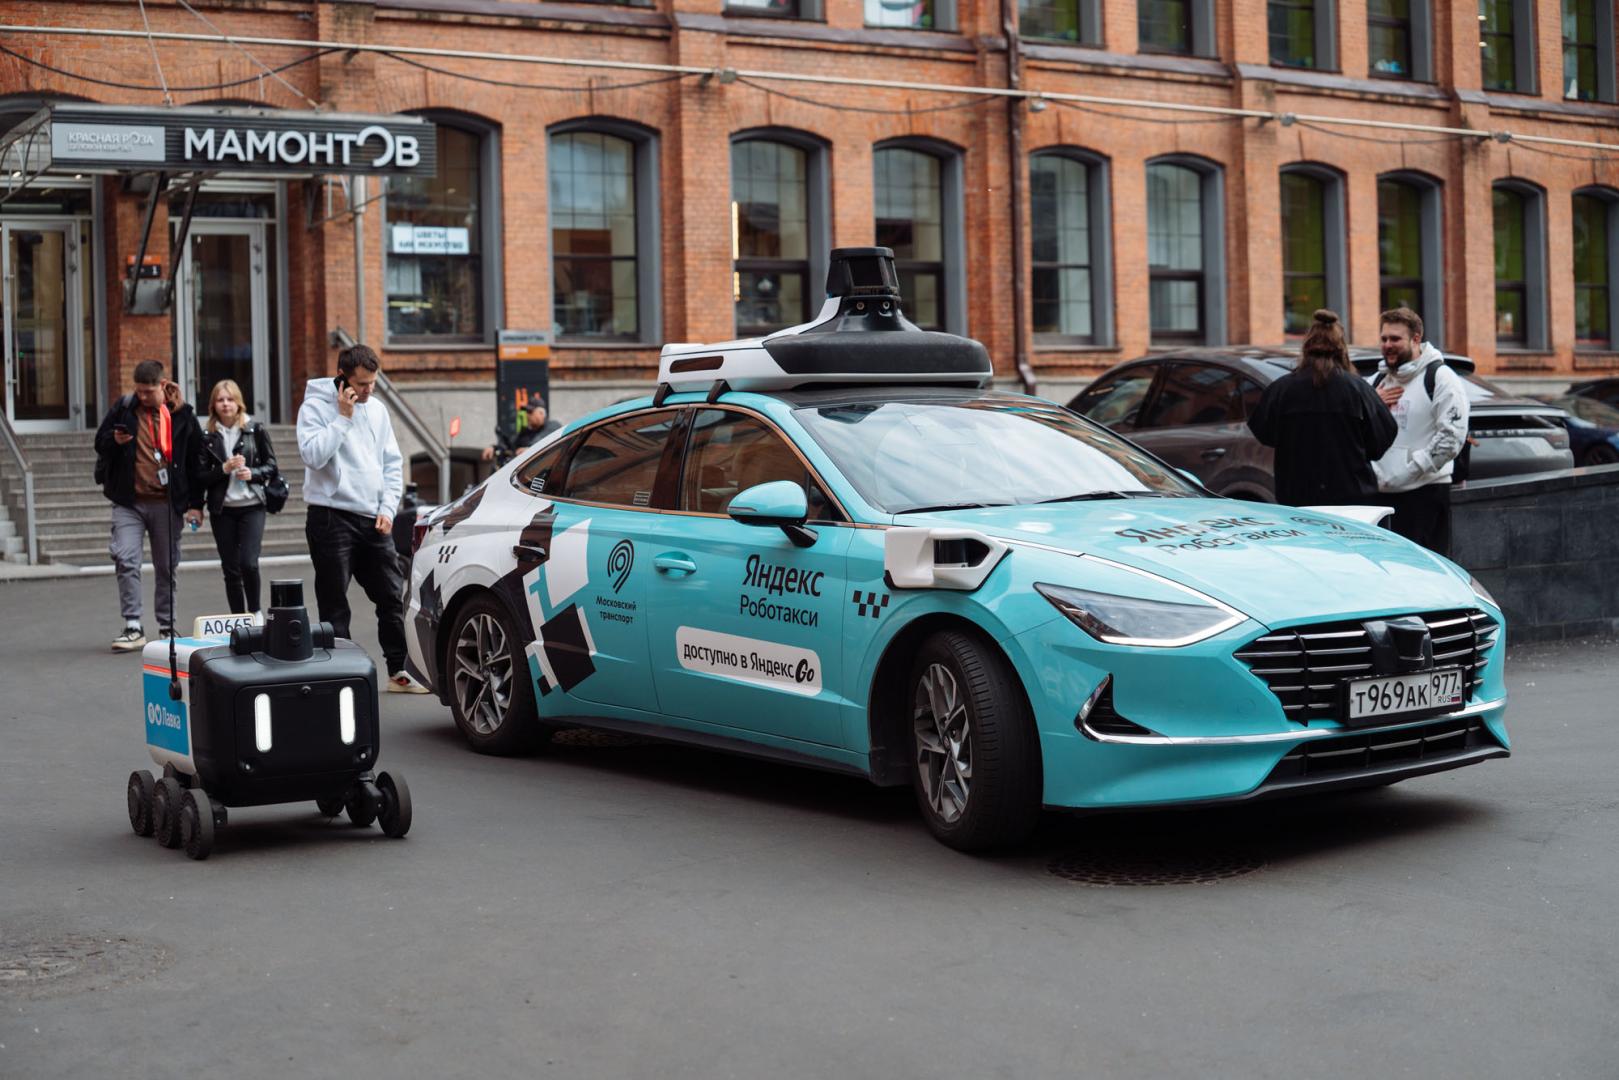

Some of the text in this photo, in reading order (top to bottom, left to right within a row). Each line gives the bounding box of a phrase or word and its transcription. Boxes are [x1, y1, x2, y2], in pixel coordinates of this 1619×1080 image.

[67, 130, 155, 146] КРАСНАЯ РОЗА
[184, 125, 421, 168] МАМОНТОВ
[742, 554, 824, 597] Яндекс
[596, 595, 637, 611] Московский
[740, 594, 818, 627] Роботакси
[600, 611, 633, 624] транспорт
[683, 644, 815, 683] доступно в Яндекс Go
[1432, 672, 1458, 696] 977
[1437, 695, 1452, 704] RUS
[162, 707, 181, 730] Лавка
